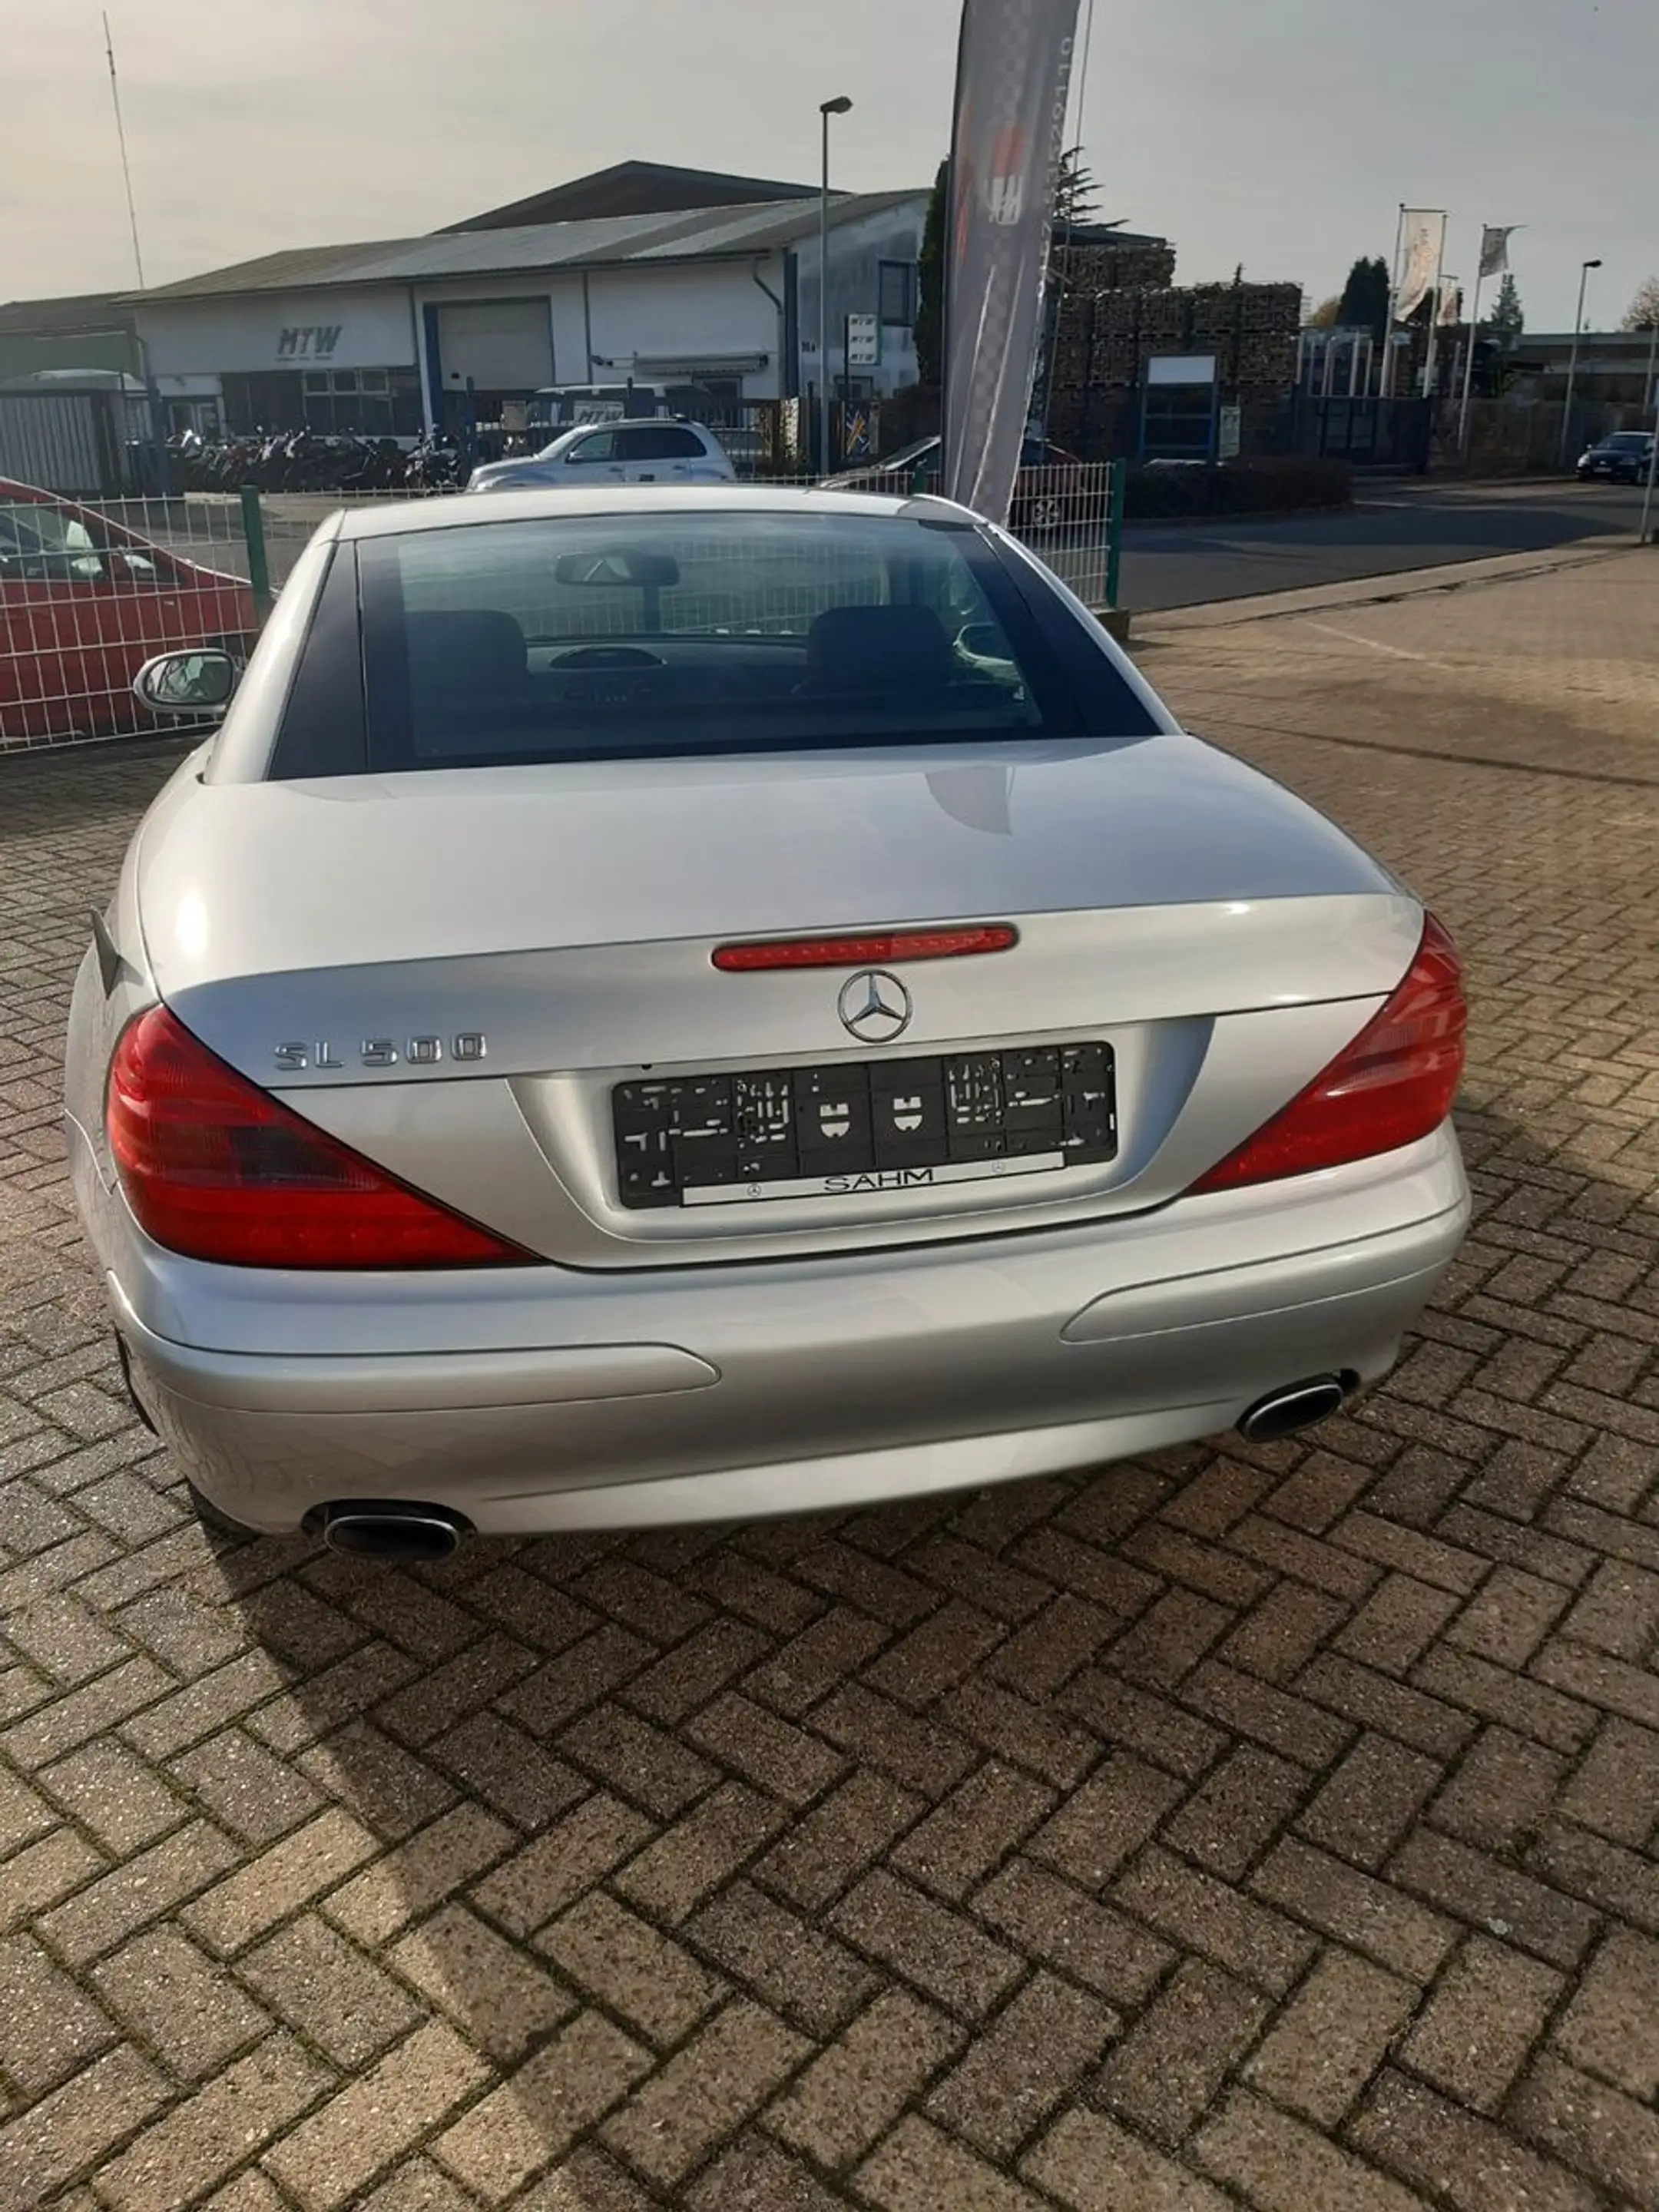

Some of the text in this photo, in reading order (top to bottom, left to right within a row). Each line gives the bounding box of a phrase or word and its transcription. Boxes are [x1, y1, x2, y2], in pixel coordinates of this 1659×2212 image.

[277, 325, 343, 355] MTW
[274, 1032, 486, 1071] SL 500
[824, 1168, 933, 1192] SAHM
